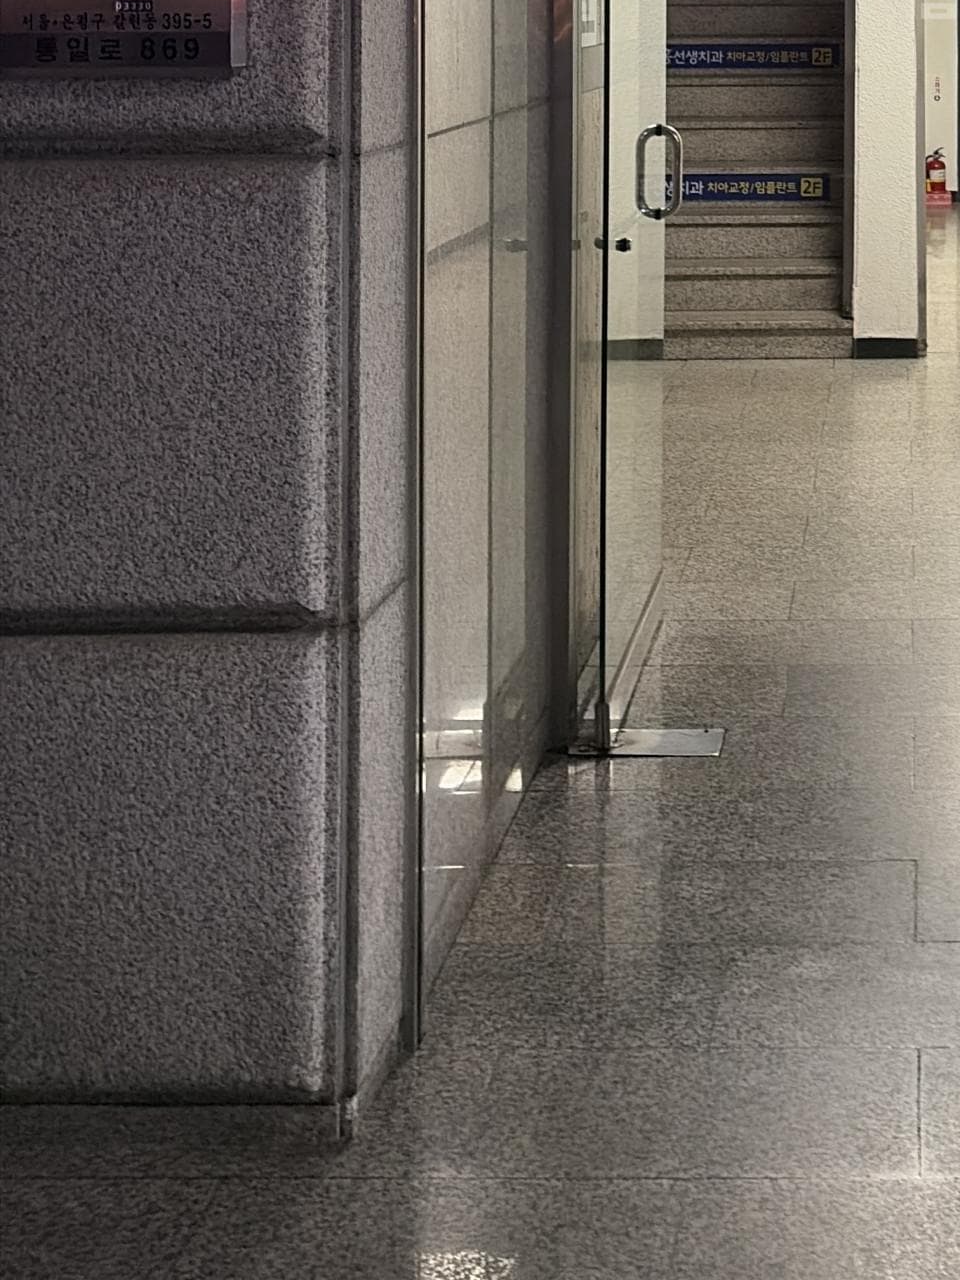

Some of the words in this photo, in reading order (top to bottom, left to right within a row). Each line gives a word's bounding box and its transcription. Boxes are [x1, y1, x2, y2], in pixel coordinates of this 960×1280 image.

[161, 13, 212, 30] 395-5
[35, 37, 122, 62] 통일로
[140, 37, 200, 61] 869
[813, 49, 831, 64] 2F
[802, 179, 822, 195] 2F
